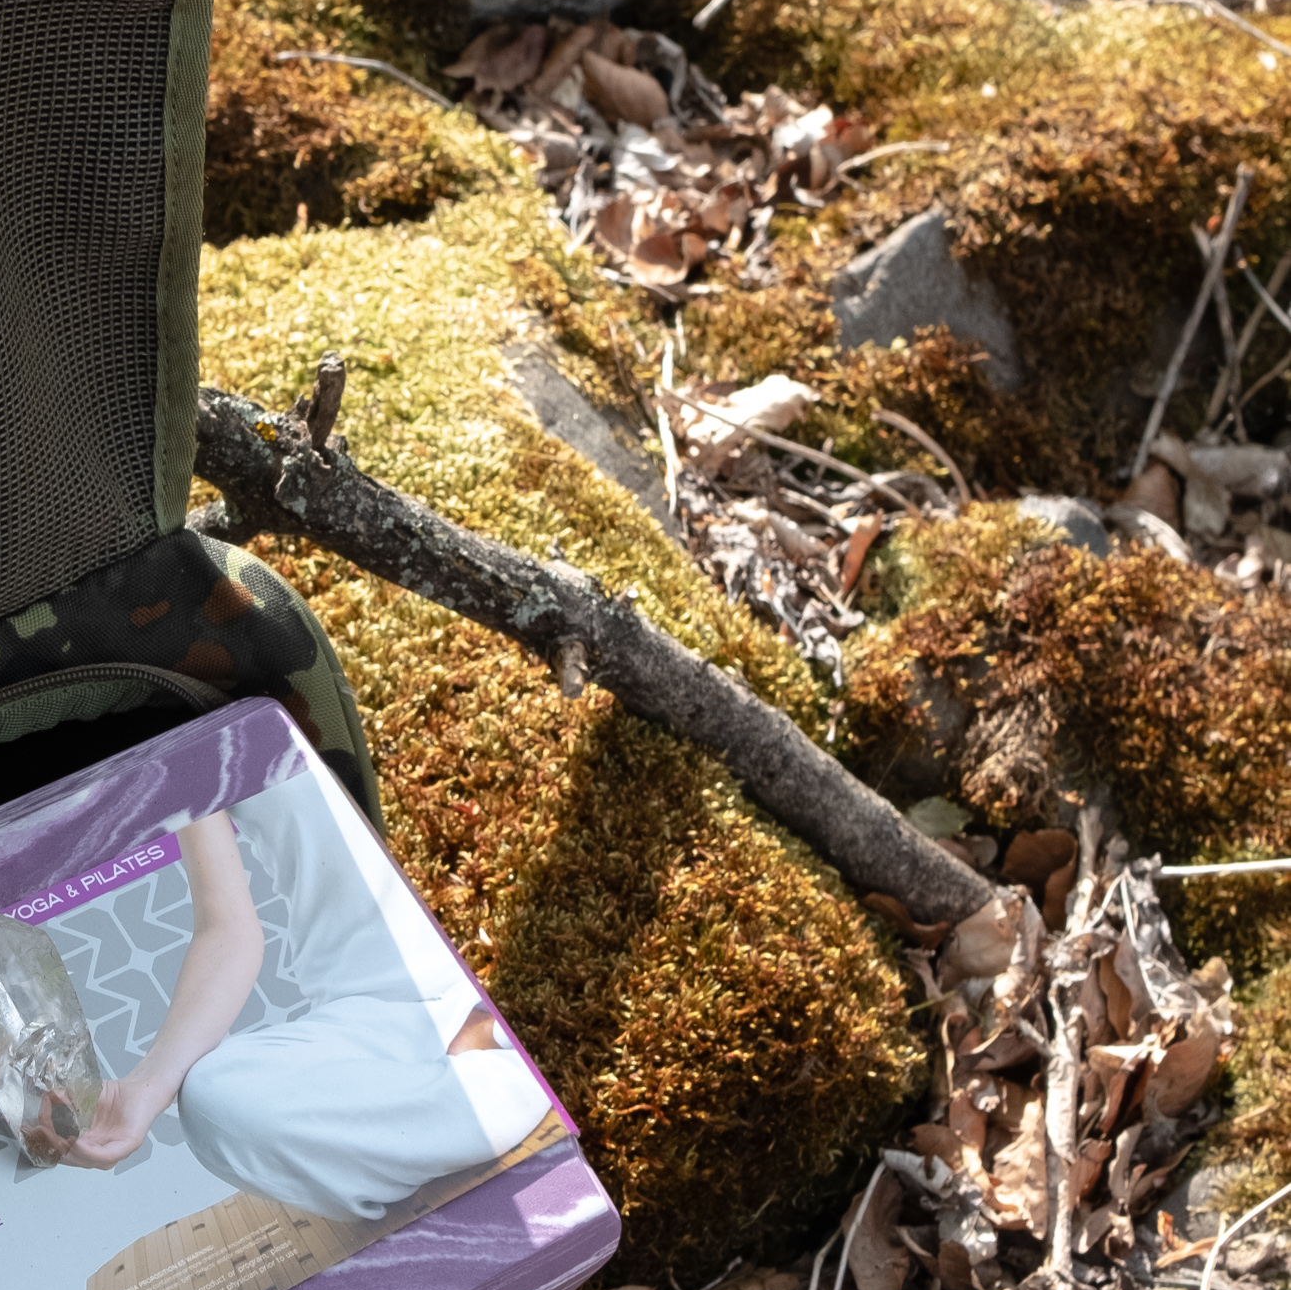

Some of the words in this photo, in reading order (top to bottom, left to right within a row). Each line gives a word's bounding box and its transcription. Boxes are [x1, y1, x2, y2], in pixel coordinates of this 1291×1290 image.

[3, 892, 64, 921] YOGA
[65, 884, 79, 898] &
[80, 843, 165, 892] PILATES
[138, 1263, 178, 1287] PROPOSITION
[177, 1259, 185, 1267] 65
[226, 1269, 236, 1278] or
[268, 1238, 293, 1255] please
[257, 1259, 276, 1274] prior
[275, 1254, 285, 1263] to
[284, 1247, 298, 1259] use
